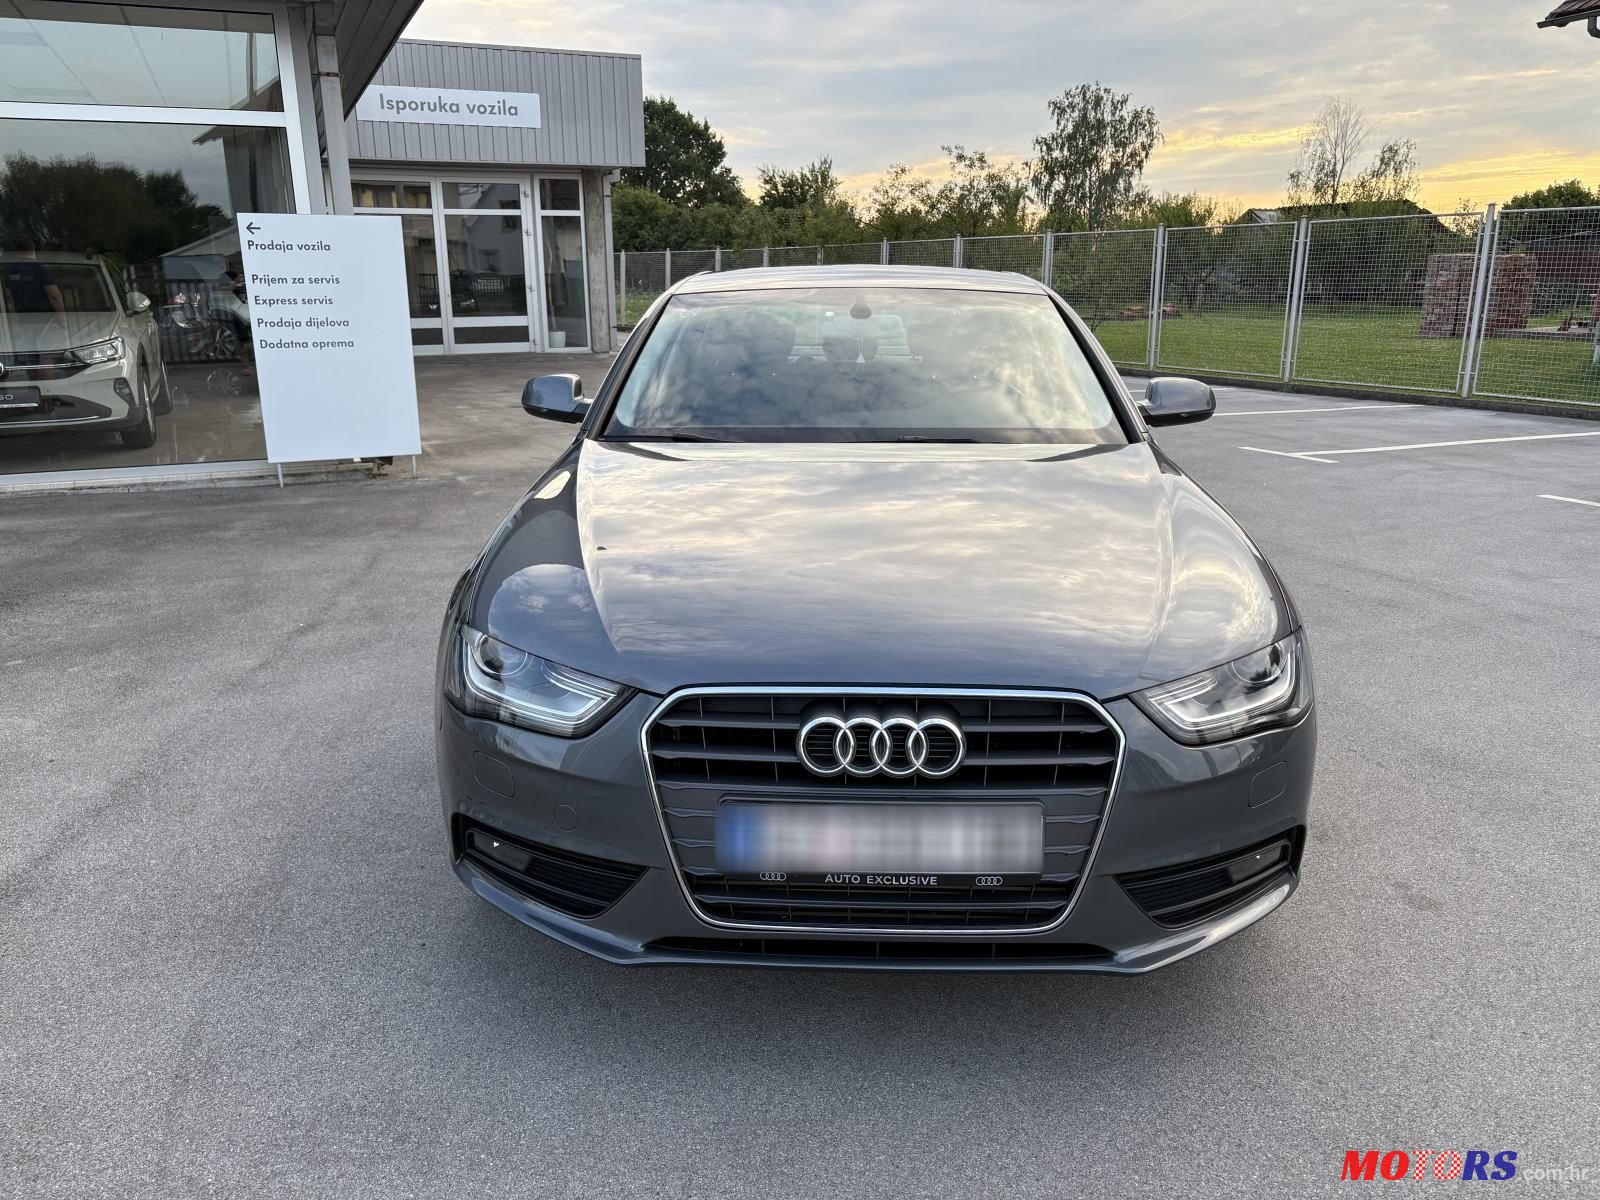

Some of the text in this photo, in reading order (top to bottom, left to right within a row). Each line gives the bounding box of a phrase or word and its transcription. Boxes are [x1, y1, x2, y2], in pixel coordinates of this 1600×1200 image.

[379, 93, 519, 116] Isporuka vozila
[247, 240, 331, 253] Prodaja vozila
[251, 274, 340, 287] Prijem za servis
[254, 295, 334, 307] Express servis
[257, 317, 350, 330] Prodaja dijelova
[259, 339, 354, 350] Dodatna oprema
[825, 874, 938, 886] AUTO EXCLUSIVE
